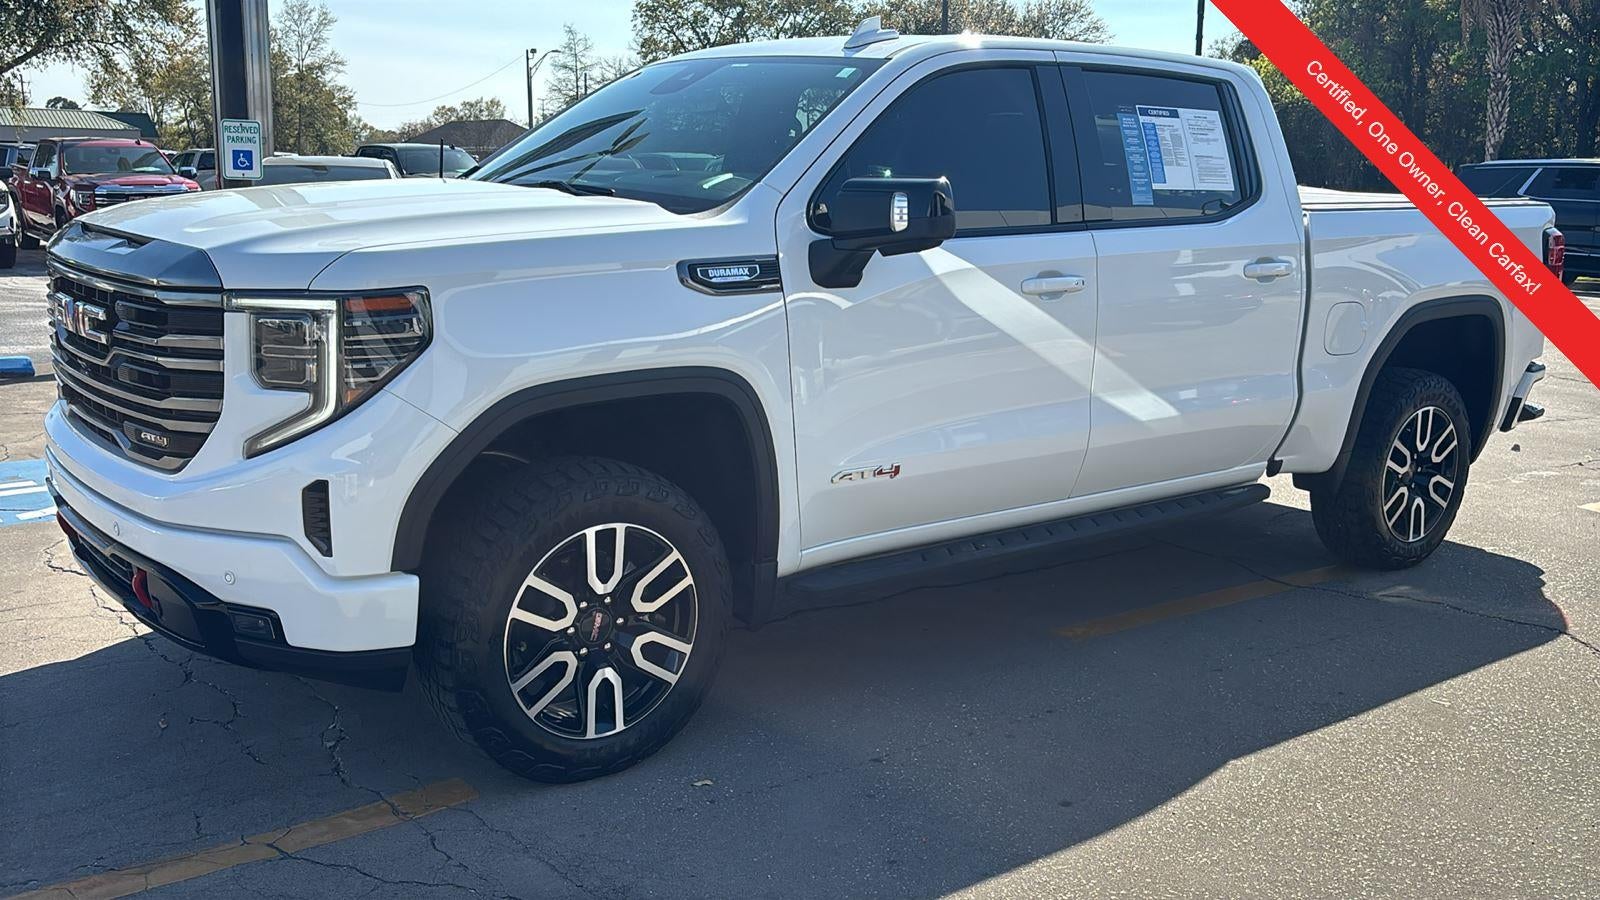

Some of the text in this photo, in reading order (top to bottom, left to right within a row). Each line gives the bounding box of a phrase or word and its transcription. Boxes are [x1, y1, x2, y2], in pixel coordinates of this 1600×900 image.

[224, 125, 259, 134] RESERVED
[227, 135, 257, 144] PARKING
[708, 267, 750, 277] DURAMAX
[831, 462, 901, 484] AT4
